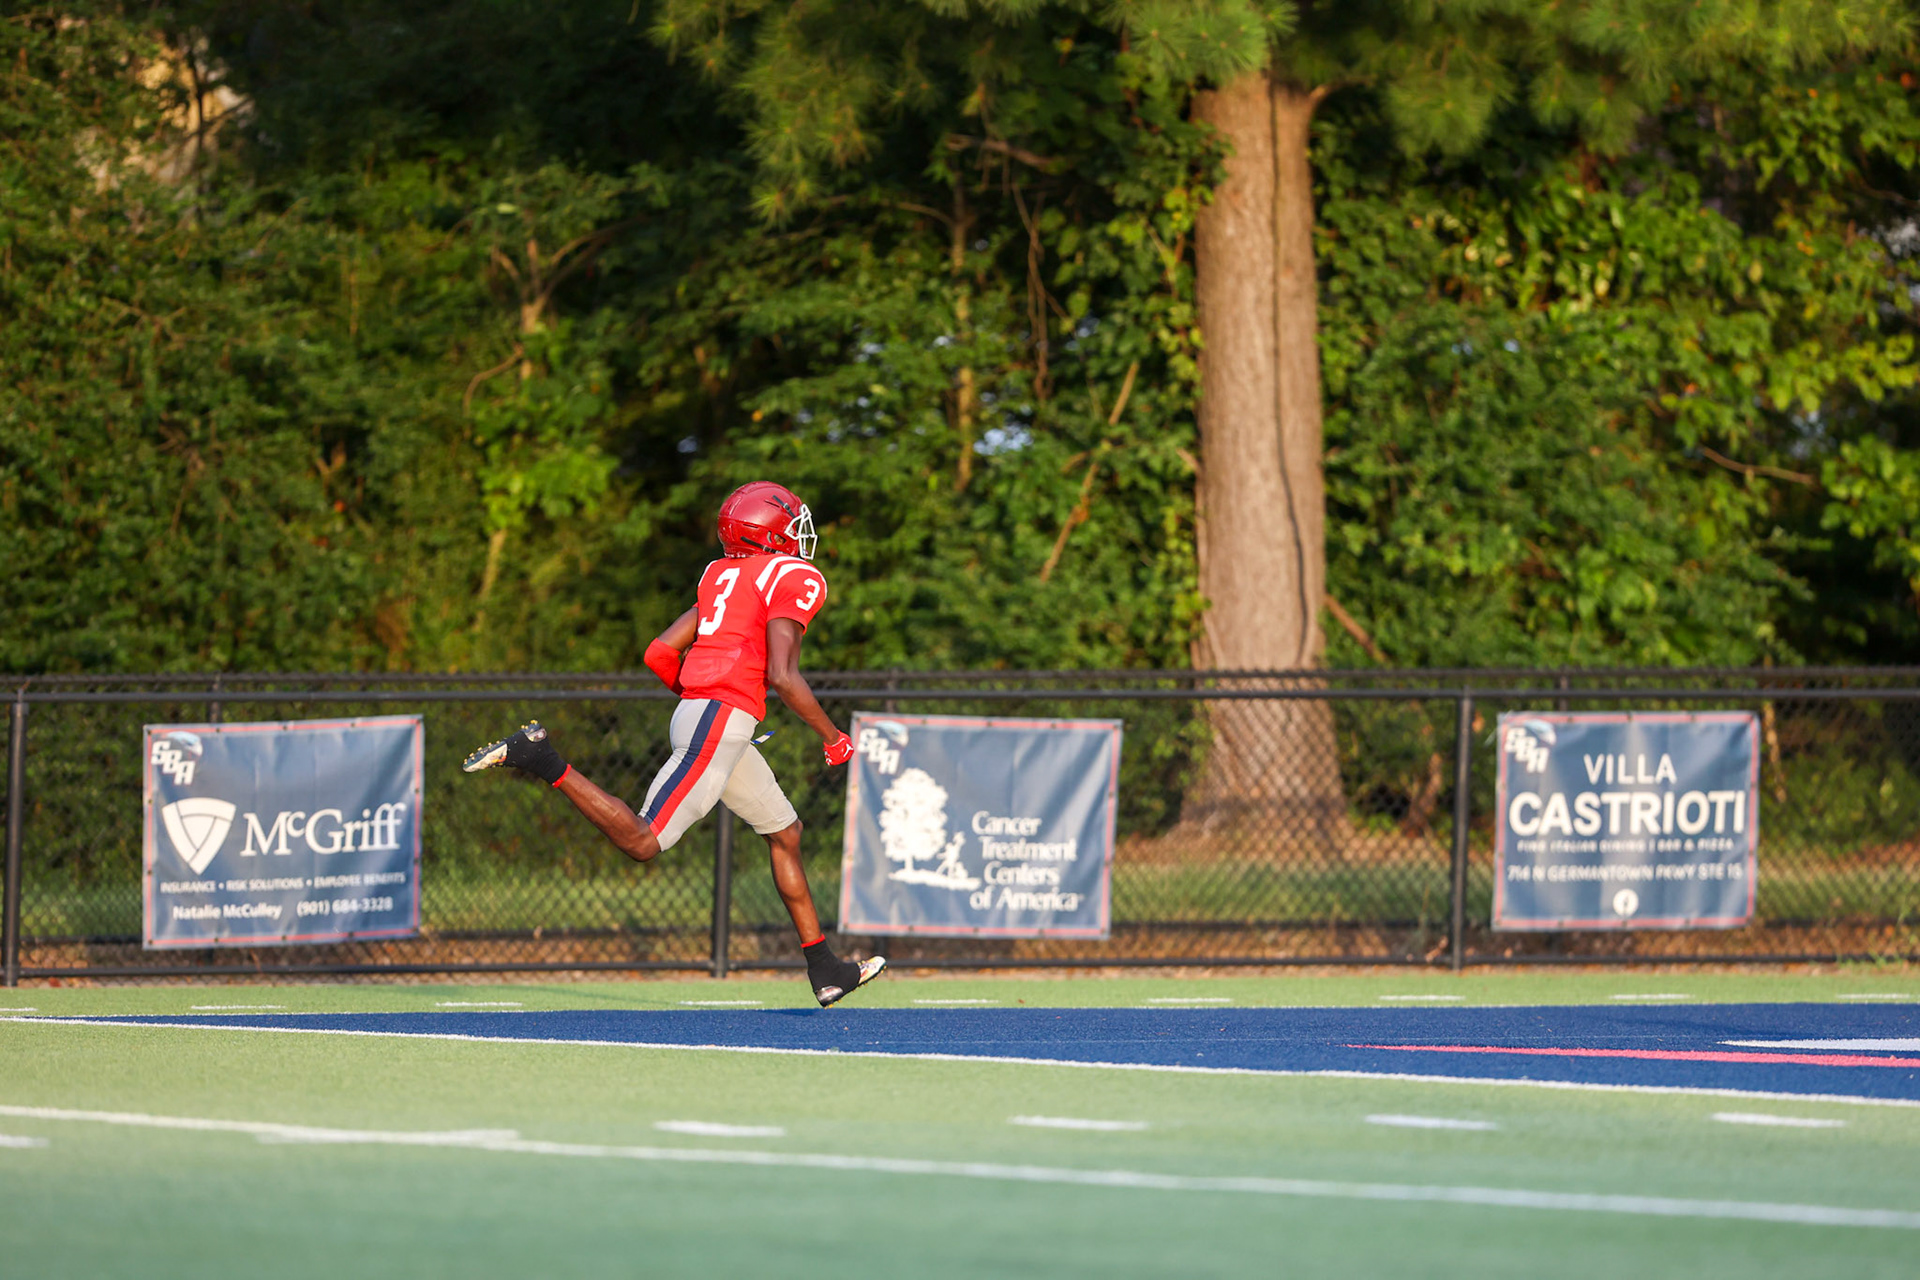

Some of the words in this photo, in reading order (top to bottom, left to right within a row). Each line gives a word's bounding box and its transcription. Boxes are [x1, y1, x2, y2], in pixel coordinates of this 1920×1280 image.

[698, 567, 740, 636] 3
[795, 578, 820, 611] 3
[1583, 753, 1677, 785] VILLA
[971, 810, 1042, 836] Cancer
[1508, 790, 1746, 837] CASTRIOTI
[240, 802, 407, 857] McGriff
[978, 836, 1078, 862] Treatment
[160, 880, 216, 893] INSURANCE
[226, 879, 247, 891] RISK
[249, 877, 304, 891] SOLUTIONS
[314, 874, 361, 889] EMPLOYEE
[984, 860, 1060, 886] Centers
[173, 904, 221, 920] Natalie
[223, 902, 282, 920] McCulley
[297, 900, 330, 917] (901)
[969, 885, 995, 910] of
